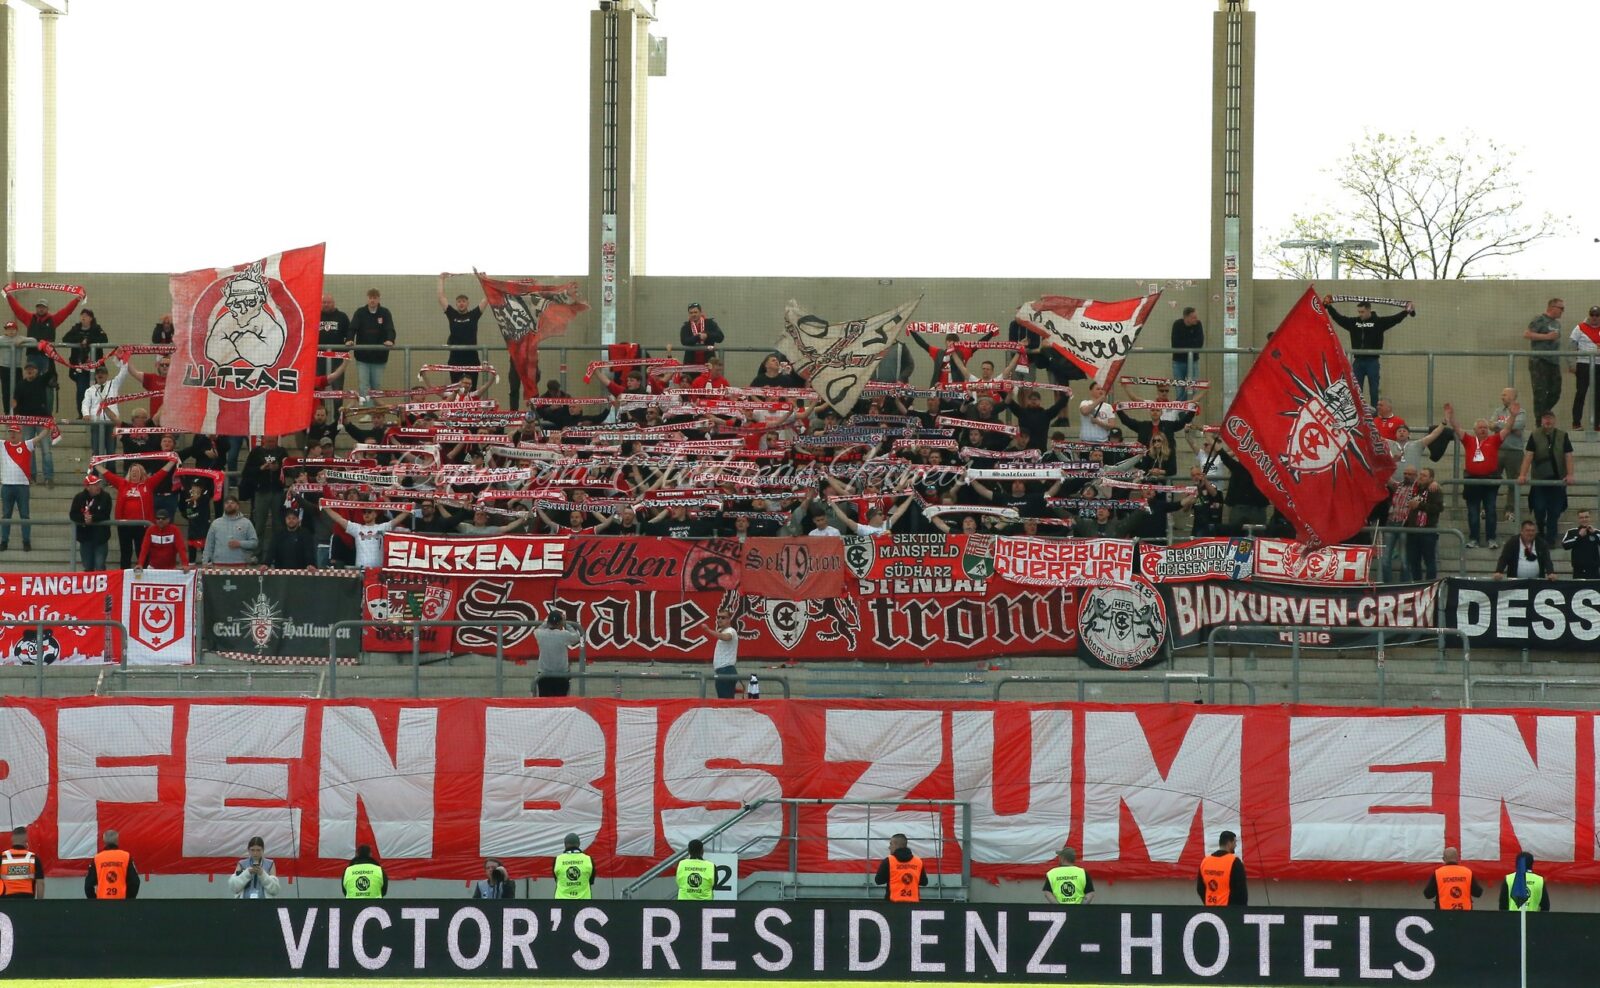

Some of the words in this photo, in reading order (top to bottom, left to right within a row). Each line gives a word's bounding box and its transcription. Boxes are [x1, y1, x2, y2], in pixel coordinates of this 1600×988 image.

[183, 364, 298, 393] ULTRAS
[892, 533, 947, 543] SEKTION
[388, 540, 565, 572] SURREALE
[880, 545, 960, 558] MANSFELD
[996, 540, 1133, 563] MERSEBURG
[1166, 544, 1227, 563] SEKTION
[562, 541, 677, 583] Köthen
[884, 561, 952, 578] SÜDHARZ
[994, 550, 1132, 581] QUERFURT
[1156, 559, 1235, 576] WEISSENFELS
[21, 574, 108, 596] FANCLUB
[134, 587, 184, 602] HFC
[859, 577, 988, 597] STENDAL
[1114, 601, 1132, 611] HFC
[1172, 585, 1437, 637] BADKURVEN-CREW
[212, 622, 242, 637] Exil
[1279, 629, 1331, 645] Halle
[479, 705, 784, 860] BIS
[824, 708, 1243, 866] ZUM
[1289, 713, 1600, 863] EN
[713, 864, 732, 892] 2
[106, 887, 118, 896] 29
[900, 889, 912, 897] 24
[276, 906, 610, 972] VICTOR'S
[641, 906, 1436, 981] RESIDENZ-HOTELS
